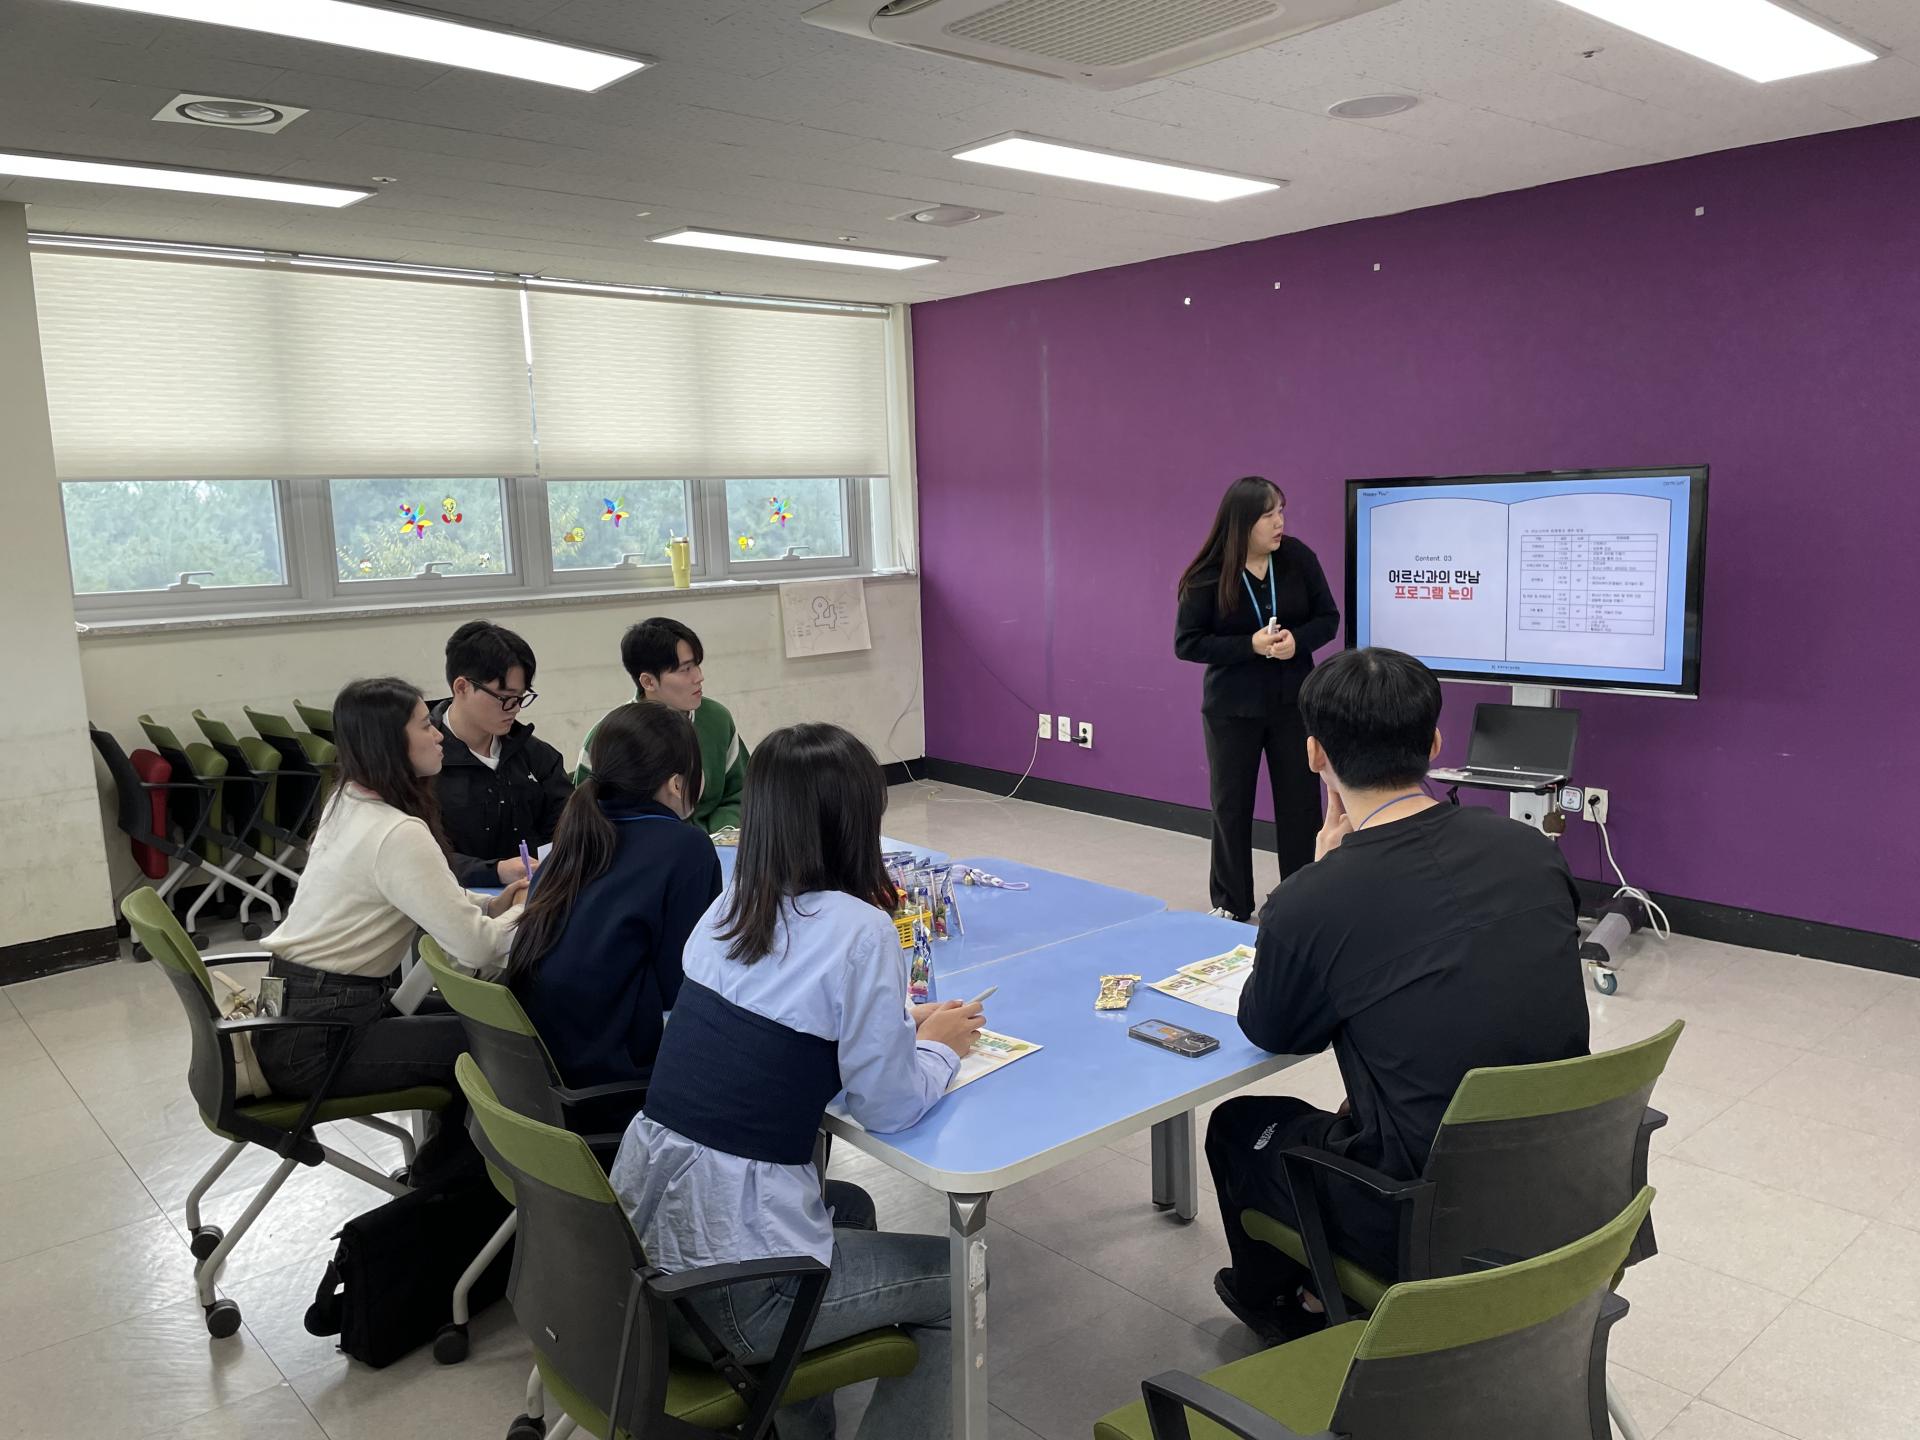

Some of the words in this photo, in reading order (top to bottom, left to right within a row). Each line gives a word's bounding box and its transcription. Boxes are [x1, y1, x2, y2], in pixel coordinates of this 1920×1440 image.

[1389, 570, 1450, 583] 어르신과의
[1455, 570, 1481, 584] 만남
[1395, 586, 1444, 600] 프로그램
[1448, 587, 1473, 600] 논의
